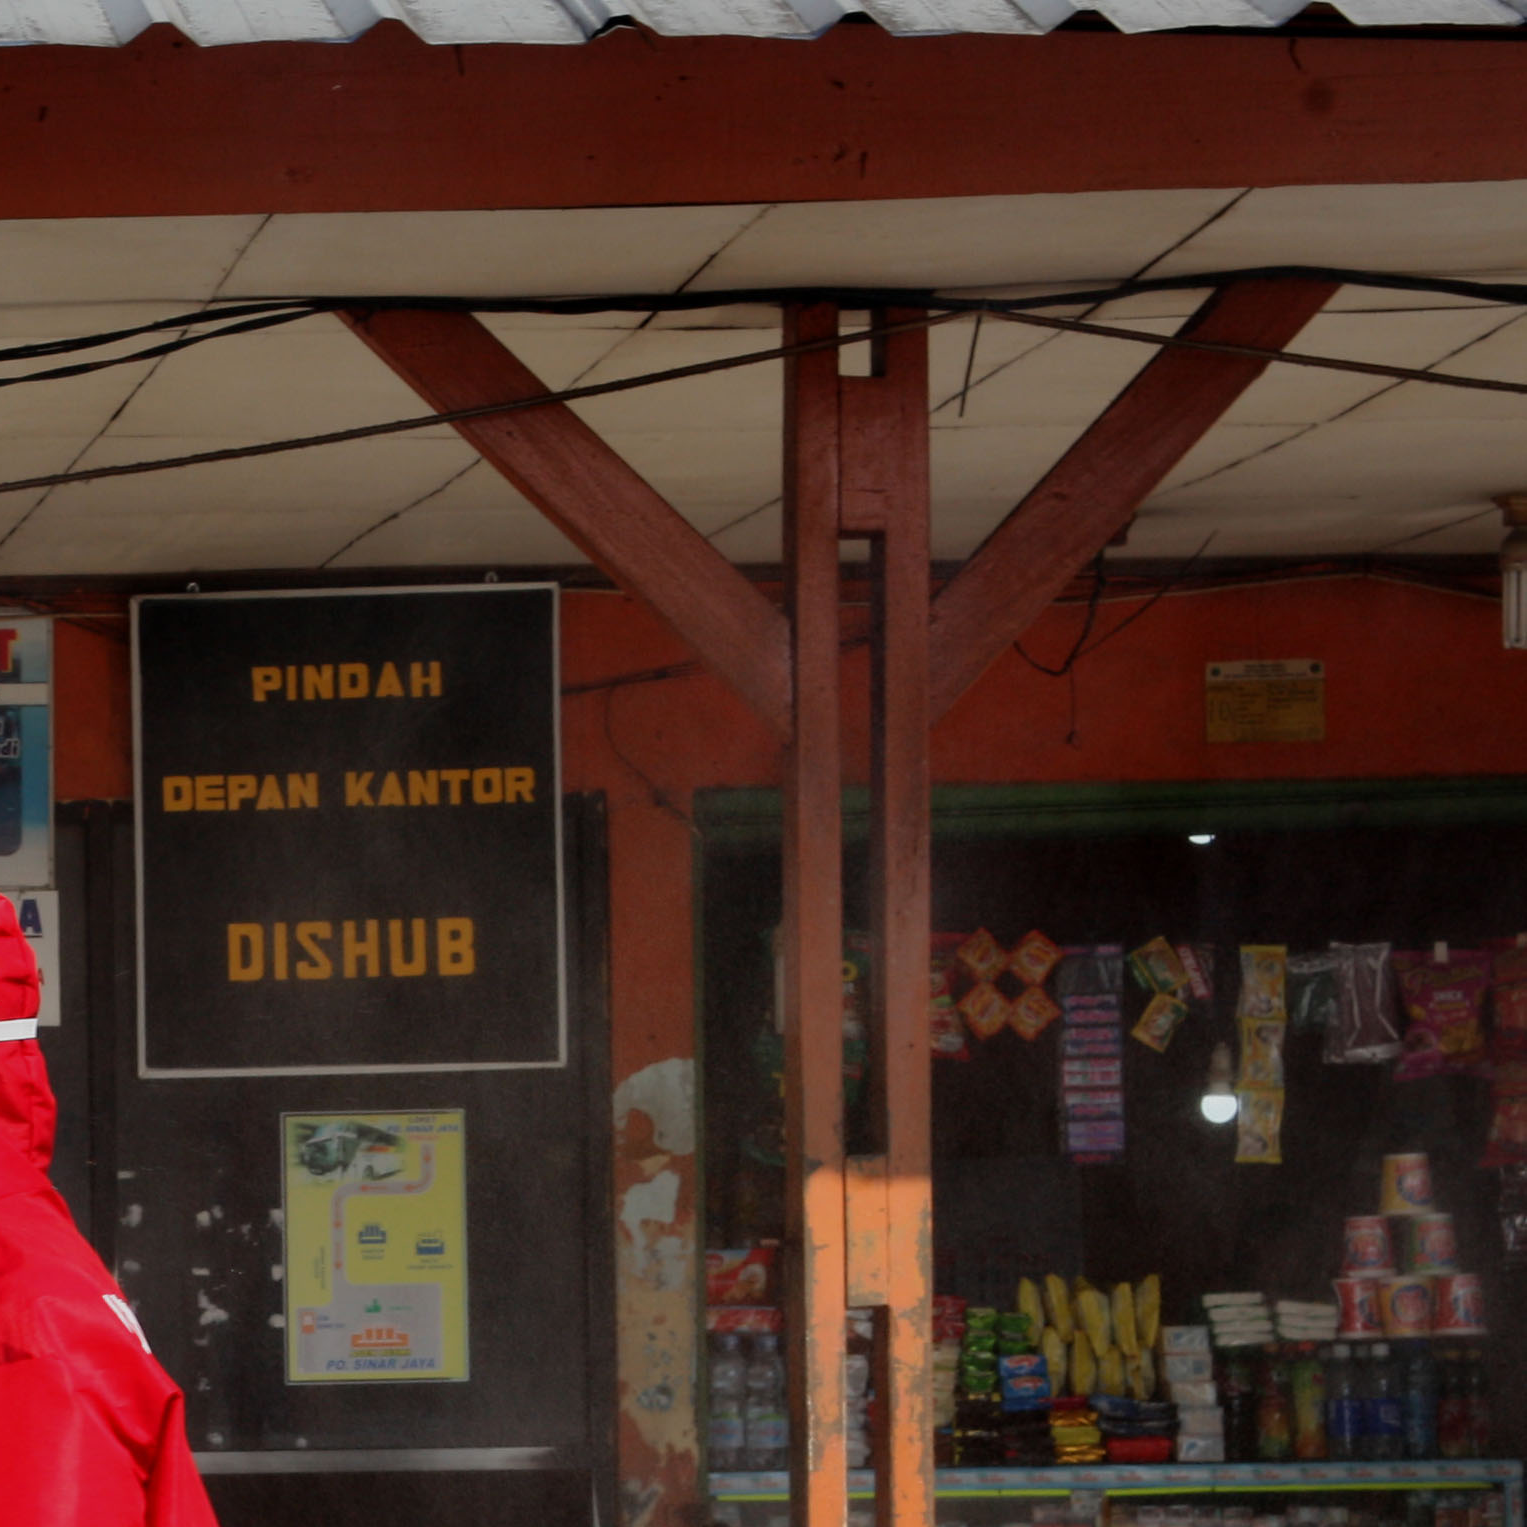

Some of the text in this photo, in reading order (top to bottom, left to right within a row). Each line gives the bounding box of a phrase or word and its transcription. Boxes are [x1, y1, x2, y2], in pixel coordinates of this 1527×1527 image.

[251, 660, 443, 701] PINDAH
[162, 766, 536, 812] DEPAN KANTOR
[227, 917, 476, 982] DISHUB
[354, 1359, 396, 1370] SINAR
[401, 1358, 436, 1369] JAYA
